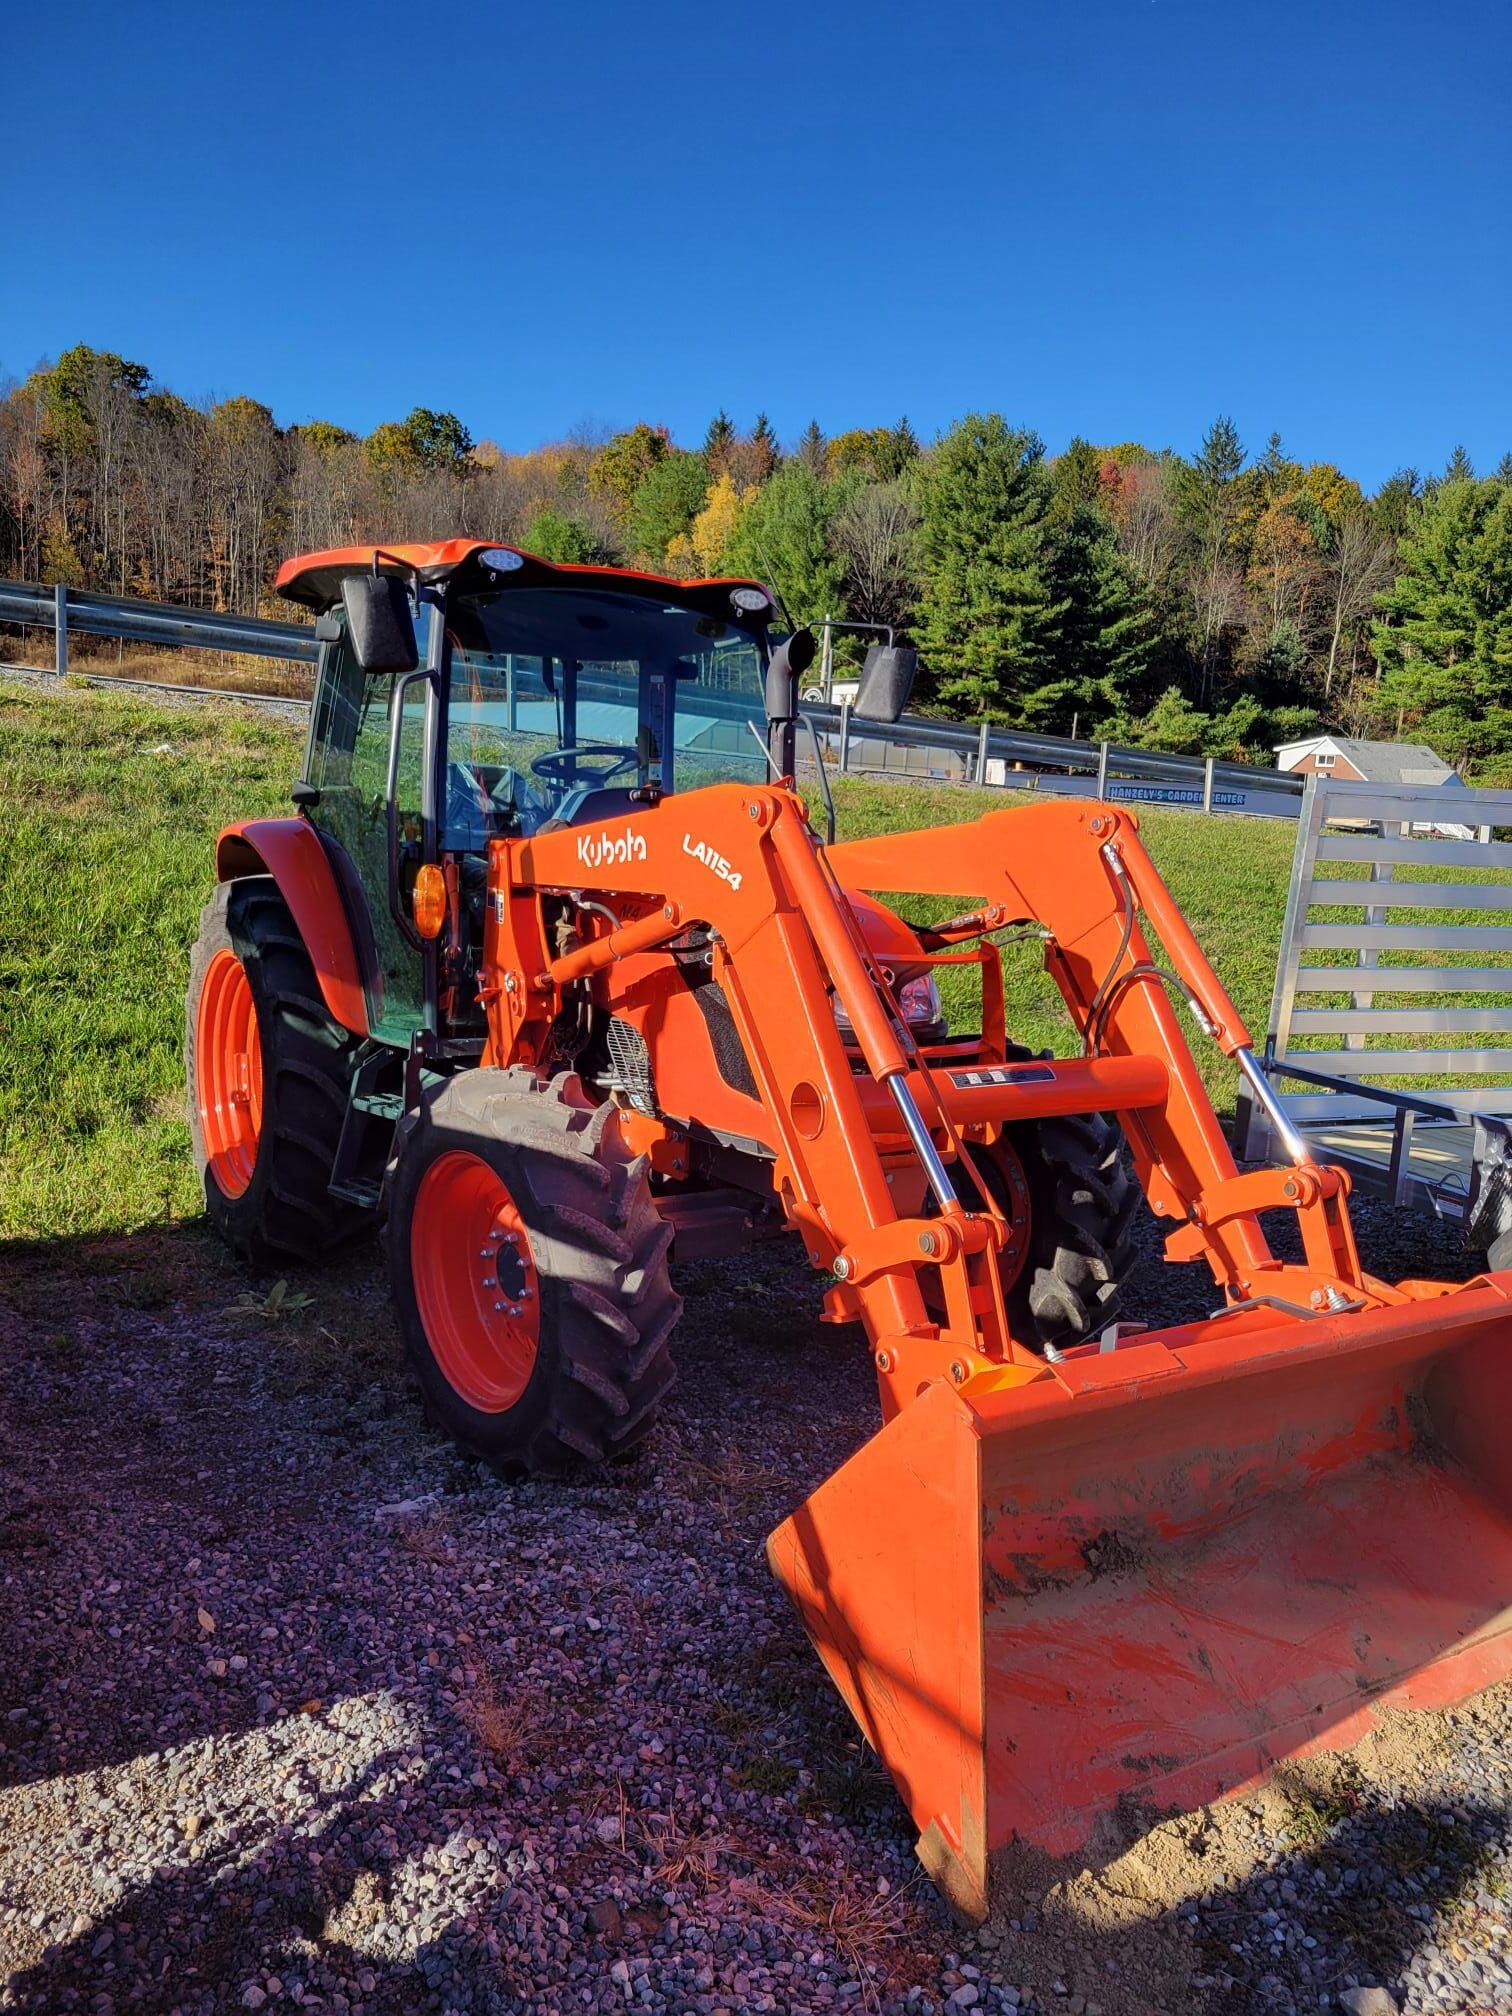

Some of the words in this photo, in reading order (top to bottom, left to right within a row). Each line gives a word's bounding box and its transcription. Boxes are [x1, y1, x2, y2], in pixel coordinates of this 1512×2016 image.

[1110, 787, 1163, 800] HANZELY'S
[1167, 790, 1205, 802] GARDEN
[1211, 793, 1244, 804] ENTER
[577, 828, 647, 867] Kubota
[682, 833, 743, 891] LA1154
